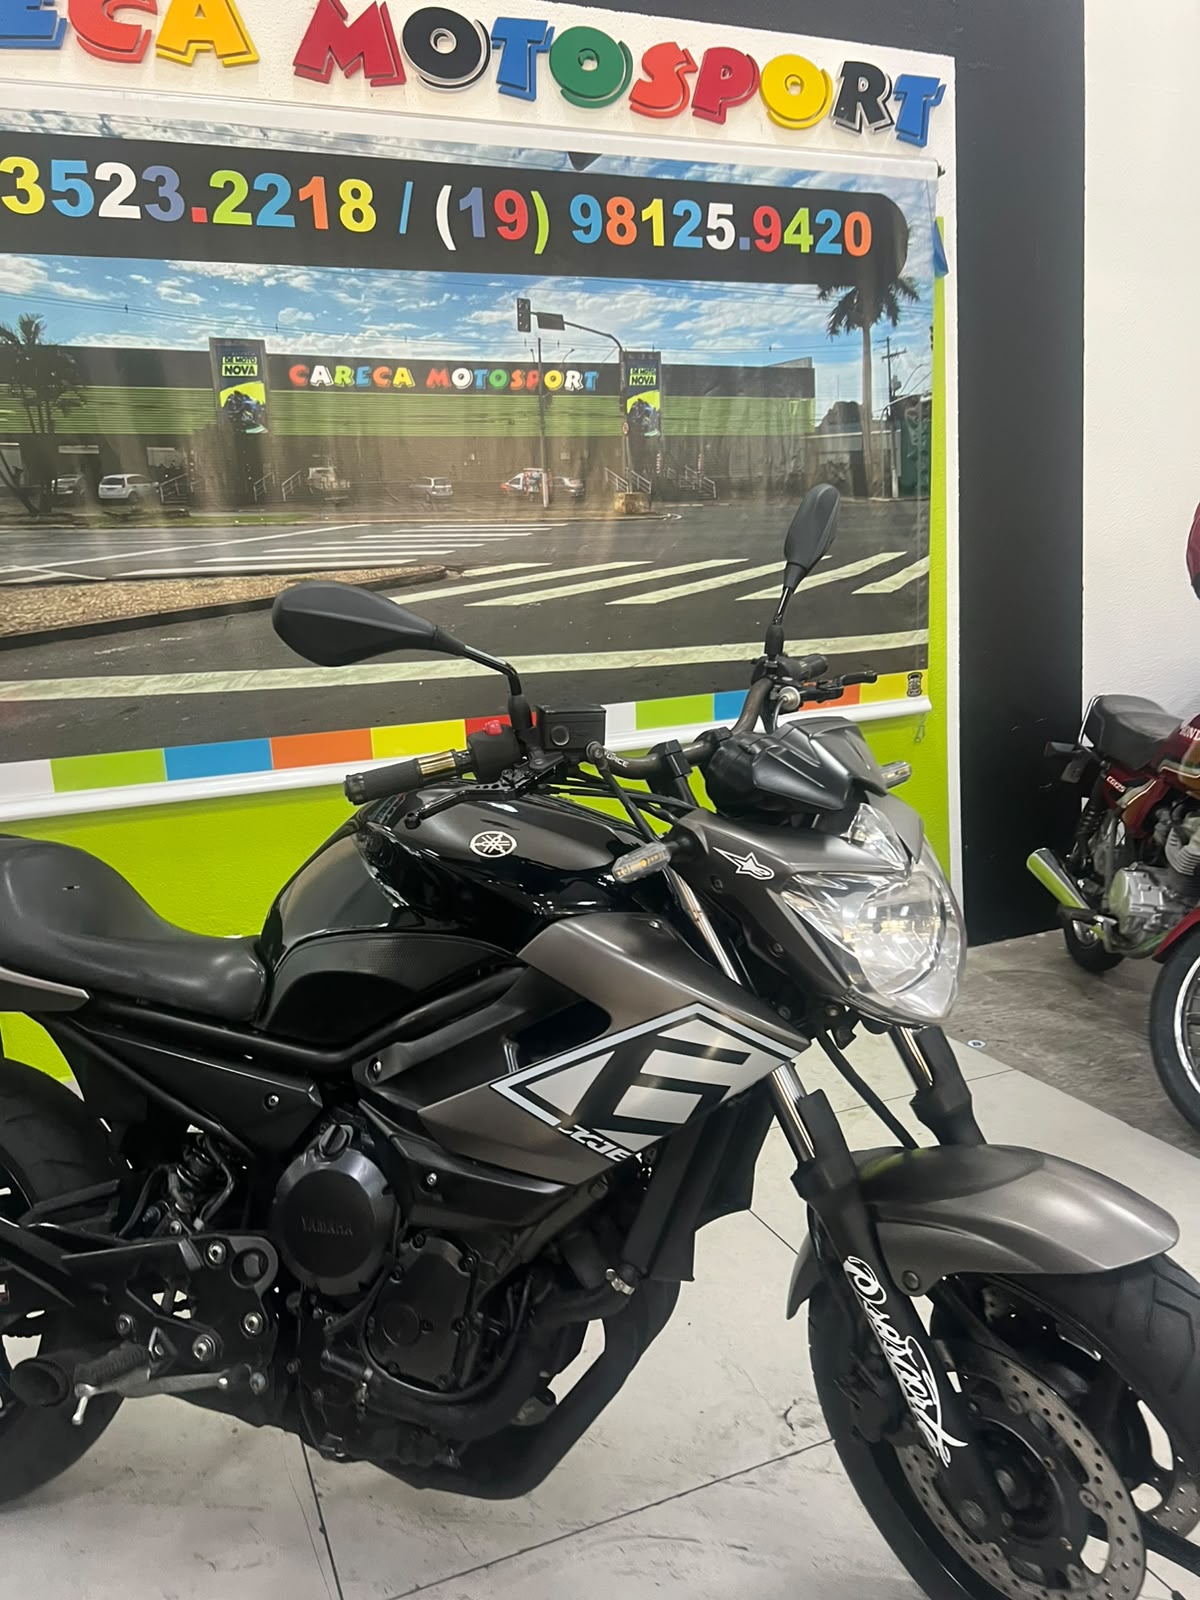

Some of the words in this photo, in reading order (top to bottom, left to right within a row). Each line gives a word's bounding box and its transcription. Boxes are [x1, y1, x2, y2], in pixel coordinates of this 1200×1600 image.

[293, 0, 946, 148] MOTOSPORT
[0, 155, 377, 233] 3523.2218
[435, 184, 549, 255] (19)
[569, 193, 872, 257] 98125.9420
[225, 365, 256, 375] NOVA
[288, 364, 416, 389] CARECA
[425, 367, 599, 391] MOTOSPORT
[631, 376, 655, 385] NOVA
